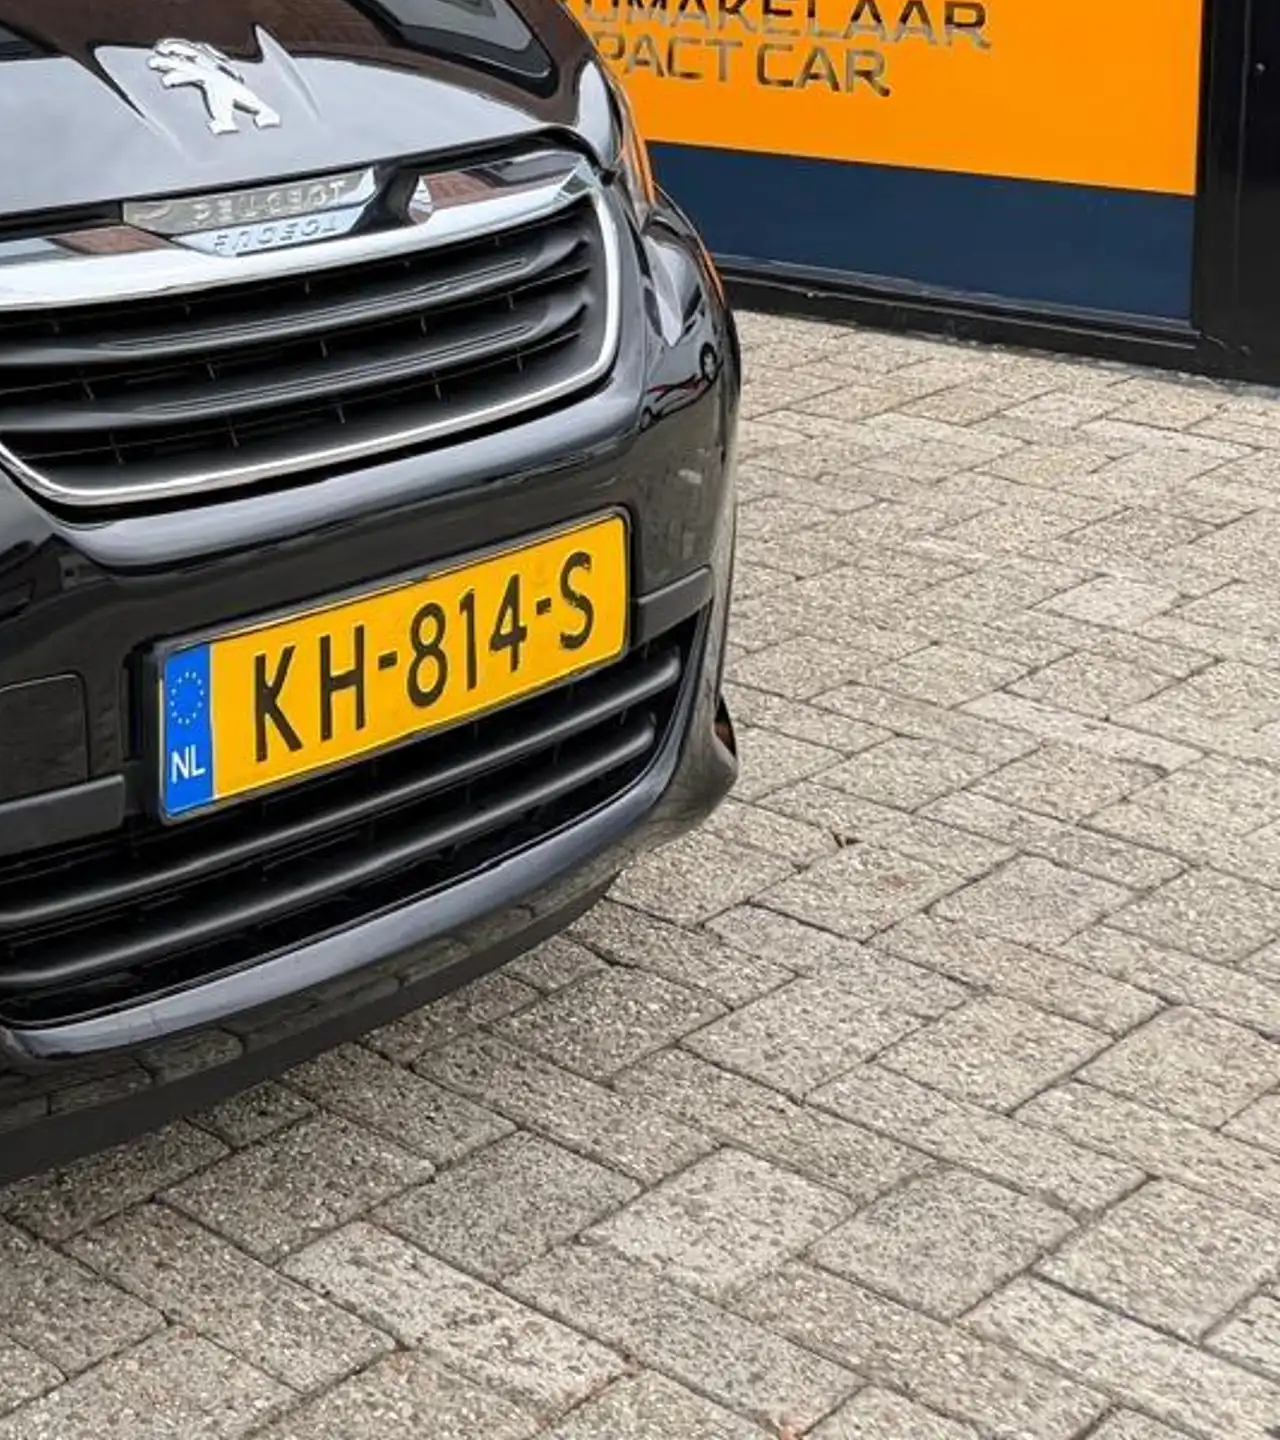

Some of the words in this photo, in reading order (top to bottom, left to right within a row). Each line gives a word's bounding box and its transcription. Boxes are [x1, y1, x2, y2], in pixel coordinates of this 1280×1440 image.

[595, 31, 742, 82] PACT
[756, 43, 890, 97] CAR
[253, 551, 594, 763] KH-814-S
[171, 746, 206, 784] NL
